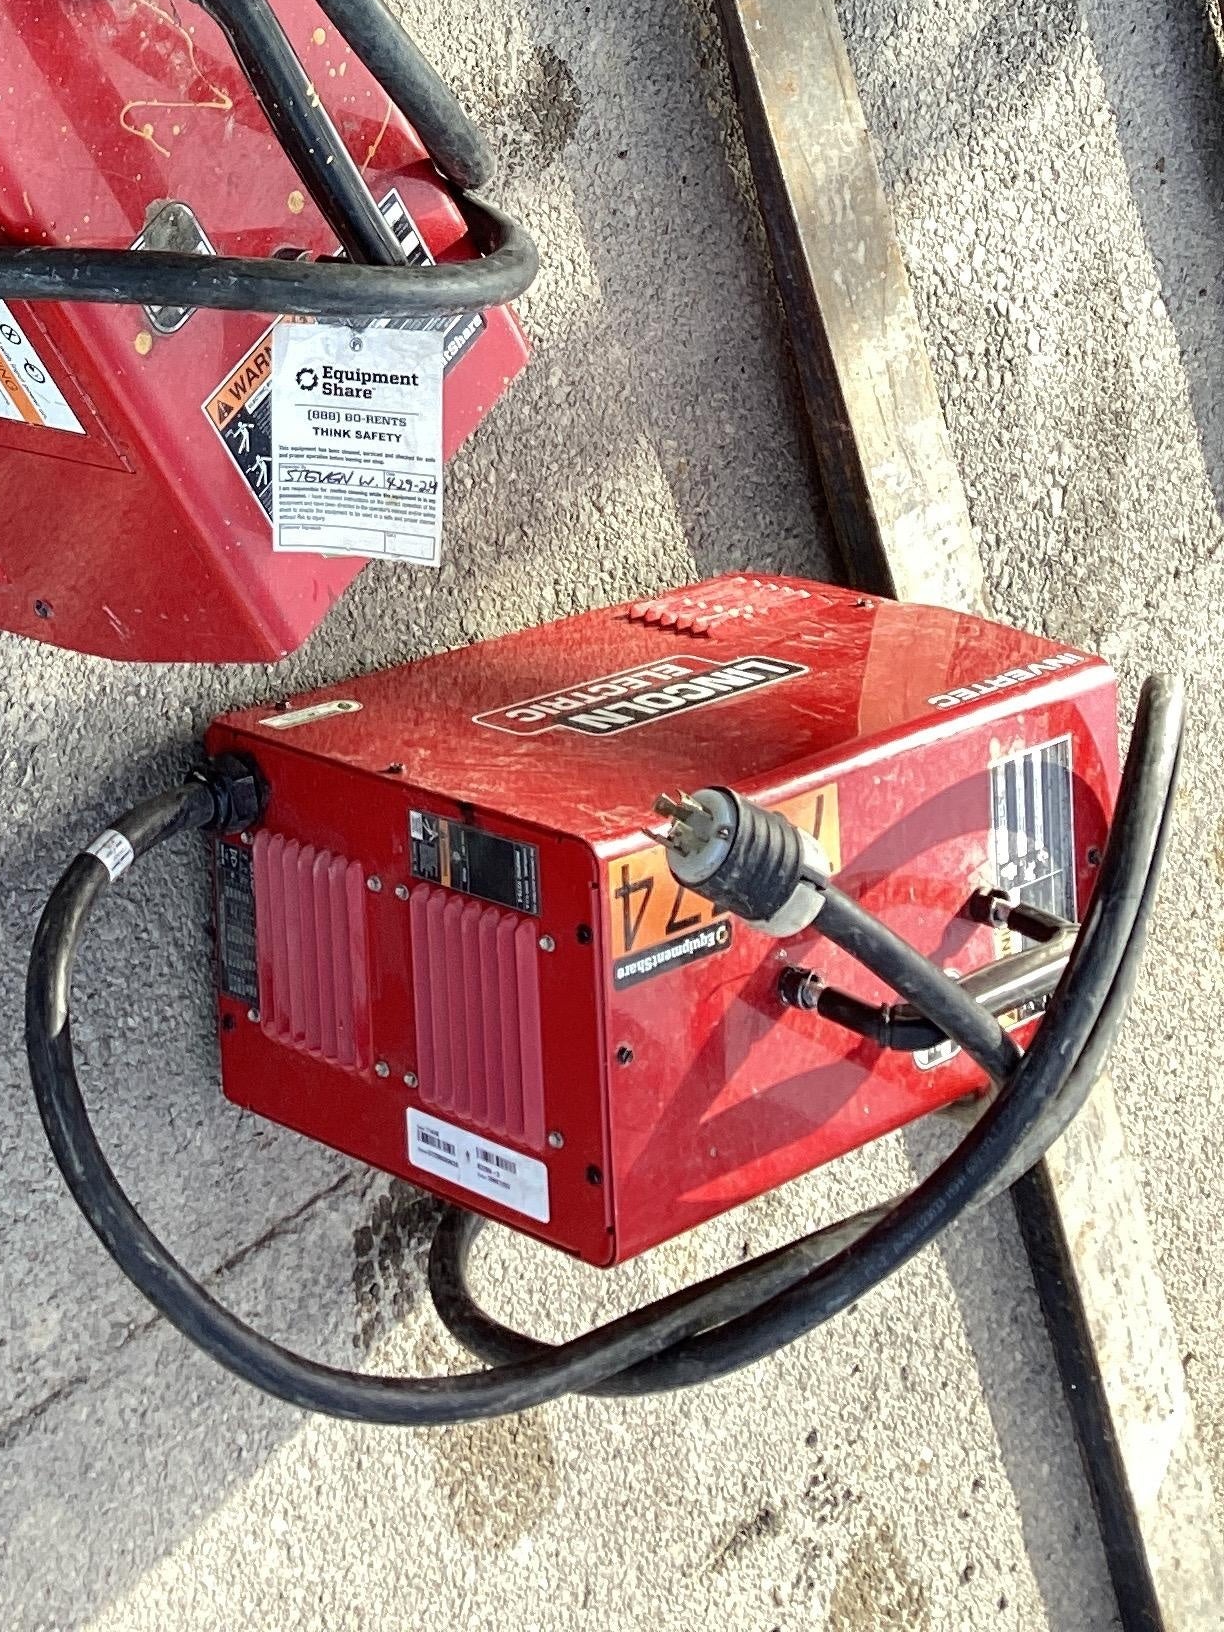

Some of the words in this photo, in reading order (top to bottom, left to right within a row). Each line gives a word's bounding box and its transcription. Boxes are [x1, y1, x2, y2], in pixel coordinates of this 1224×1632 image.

[322, 366, 419, 386] Equipment
[322, 382, 373, 399] Share
[312, 426, 351, 439] THINK
[355, 430, 402, 443] SAFETY
[285, 469, 354, 485] STEVEN
[506, 664, 693, 722] ELECTRIC
[568, 661, 790, 729] LINCOLN
[928, 652, 1085, 710] INVERTEC
[617, 932, 716, 979] EquipmentShare
